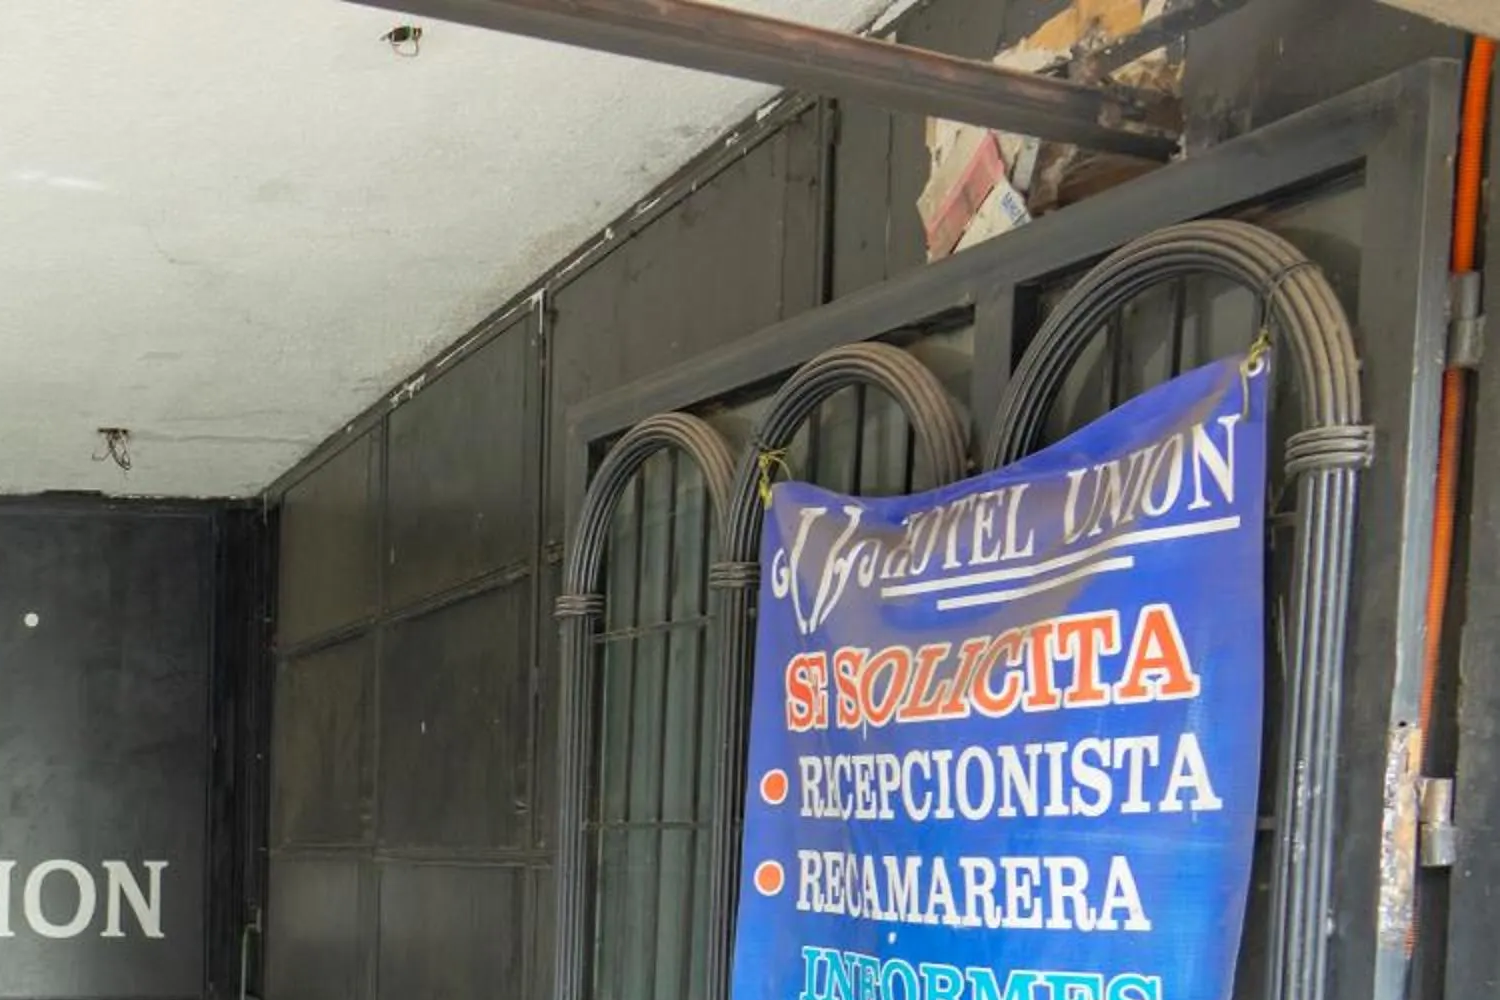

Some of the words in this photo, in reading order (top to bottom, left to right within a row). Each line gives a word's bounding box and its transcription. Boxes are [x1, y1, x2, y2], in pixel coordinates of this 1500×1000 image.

[879, 483, 1035, 580] HOTEL
[1062, 413, 1240, 544] UNION
[832, 602, 1200, 730] SOLICITA
[795, 849, 1153, 932] RECAMARERA
